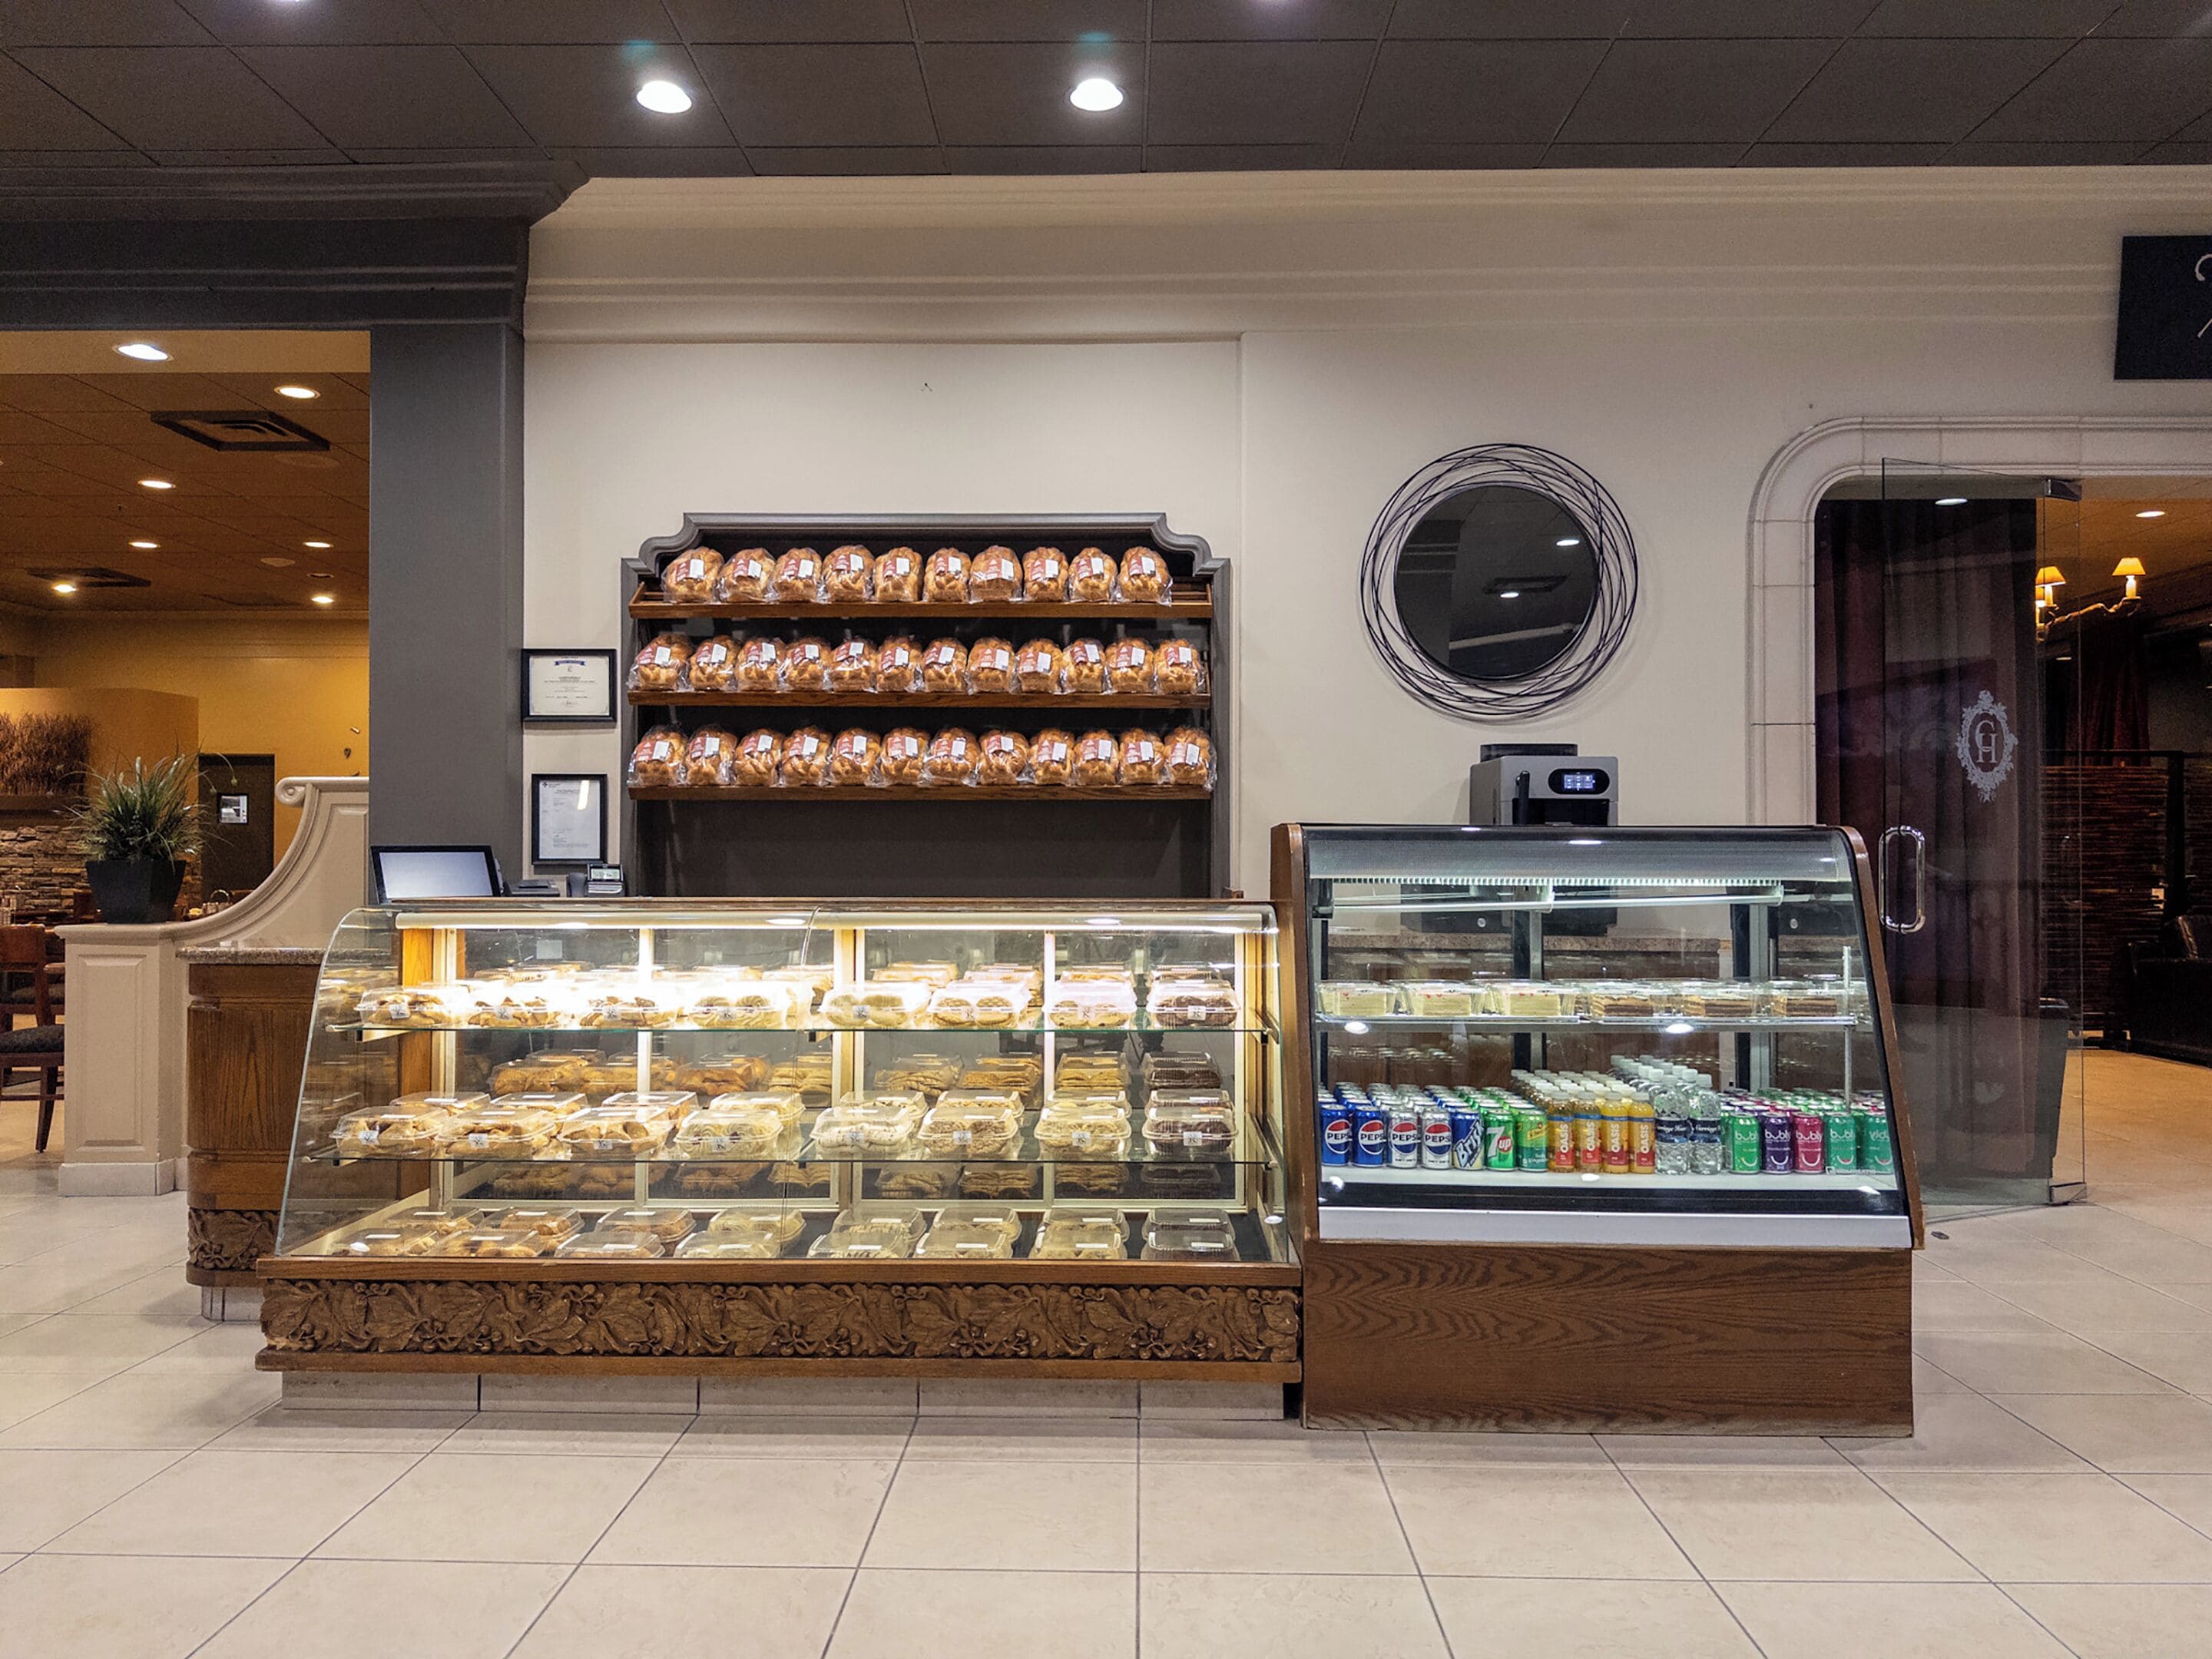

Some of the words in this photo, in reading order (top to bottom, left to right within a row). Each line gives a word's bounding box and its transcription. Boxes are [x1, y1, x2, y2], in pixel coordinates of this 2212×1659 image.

[1425, 1134, 1451, 1143] PEPS
[1560, 1124, 1569, 1153] OASIS
[1587, 1121, 1595, 1151] OASIS
[1611, 1124, 1621, 1153] OASIS
[1640, 1124, 1649, 1154] OASIS
[1764, 1128, 1791, 1141] bubly
[1796, 1130, 1823, 1143] bubly
[1830, 1128, 1854, 1139] bubl
